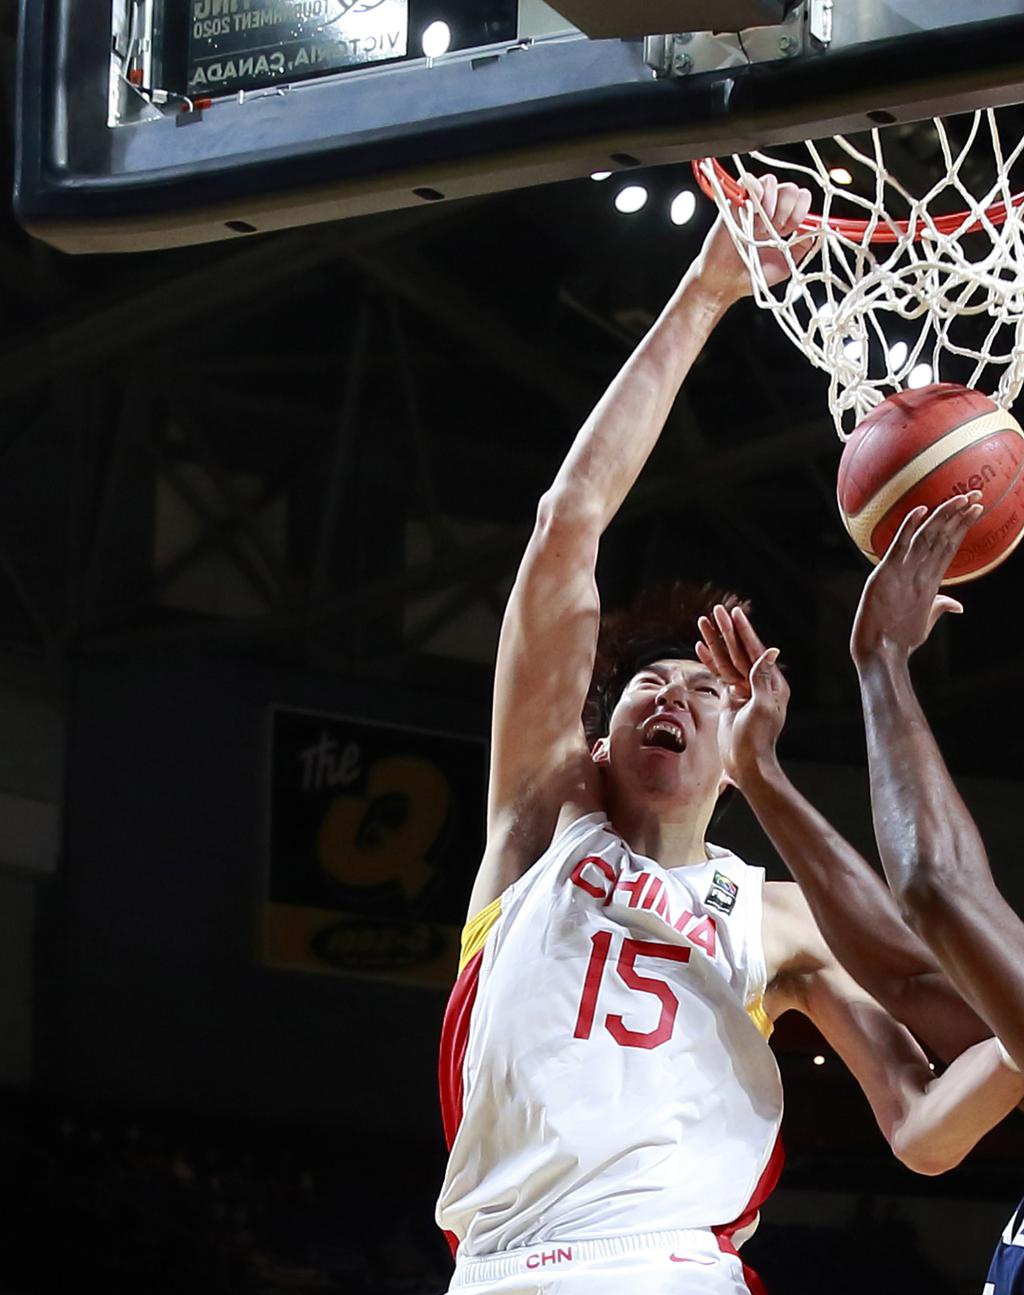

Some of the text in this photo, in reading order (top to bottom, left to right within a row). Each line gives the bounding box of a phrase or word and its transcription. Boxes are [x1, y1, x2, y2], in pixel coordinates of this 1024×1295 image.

[570, 856, 717, 959] CHINA
[573, 930, 692, 1050] 15
[526, 1247, 573, 1269] CHN
